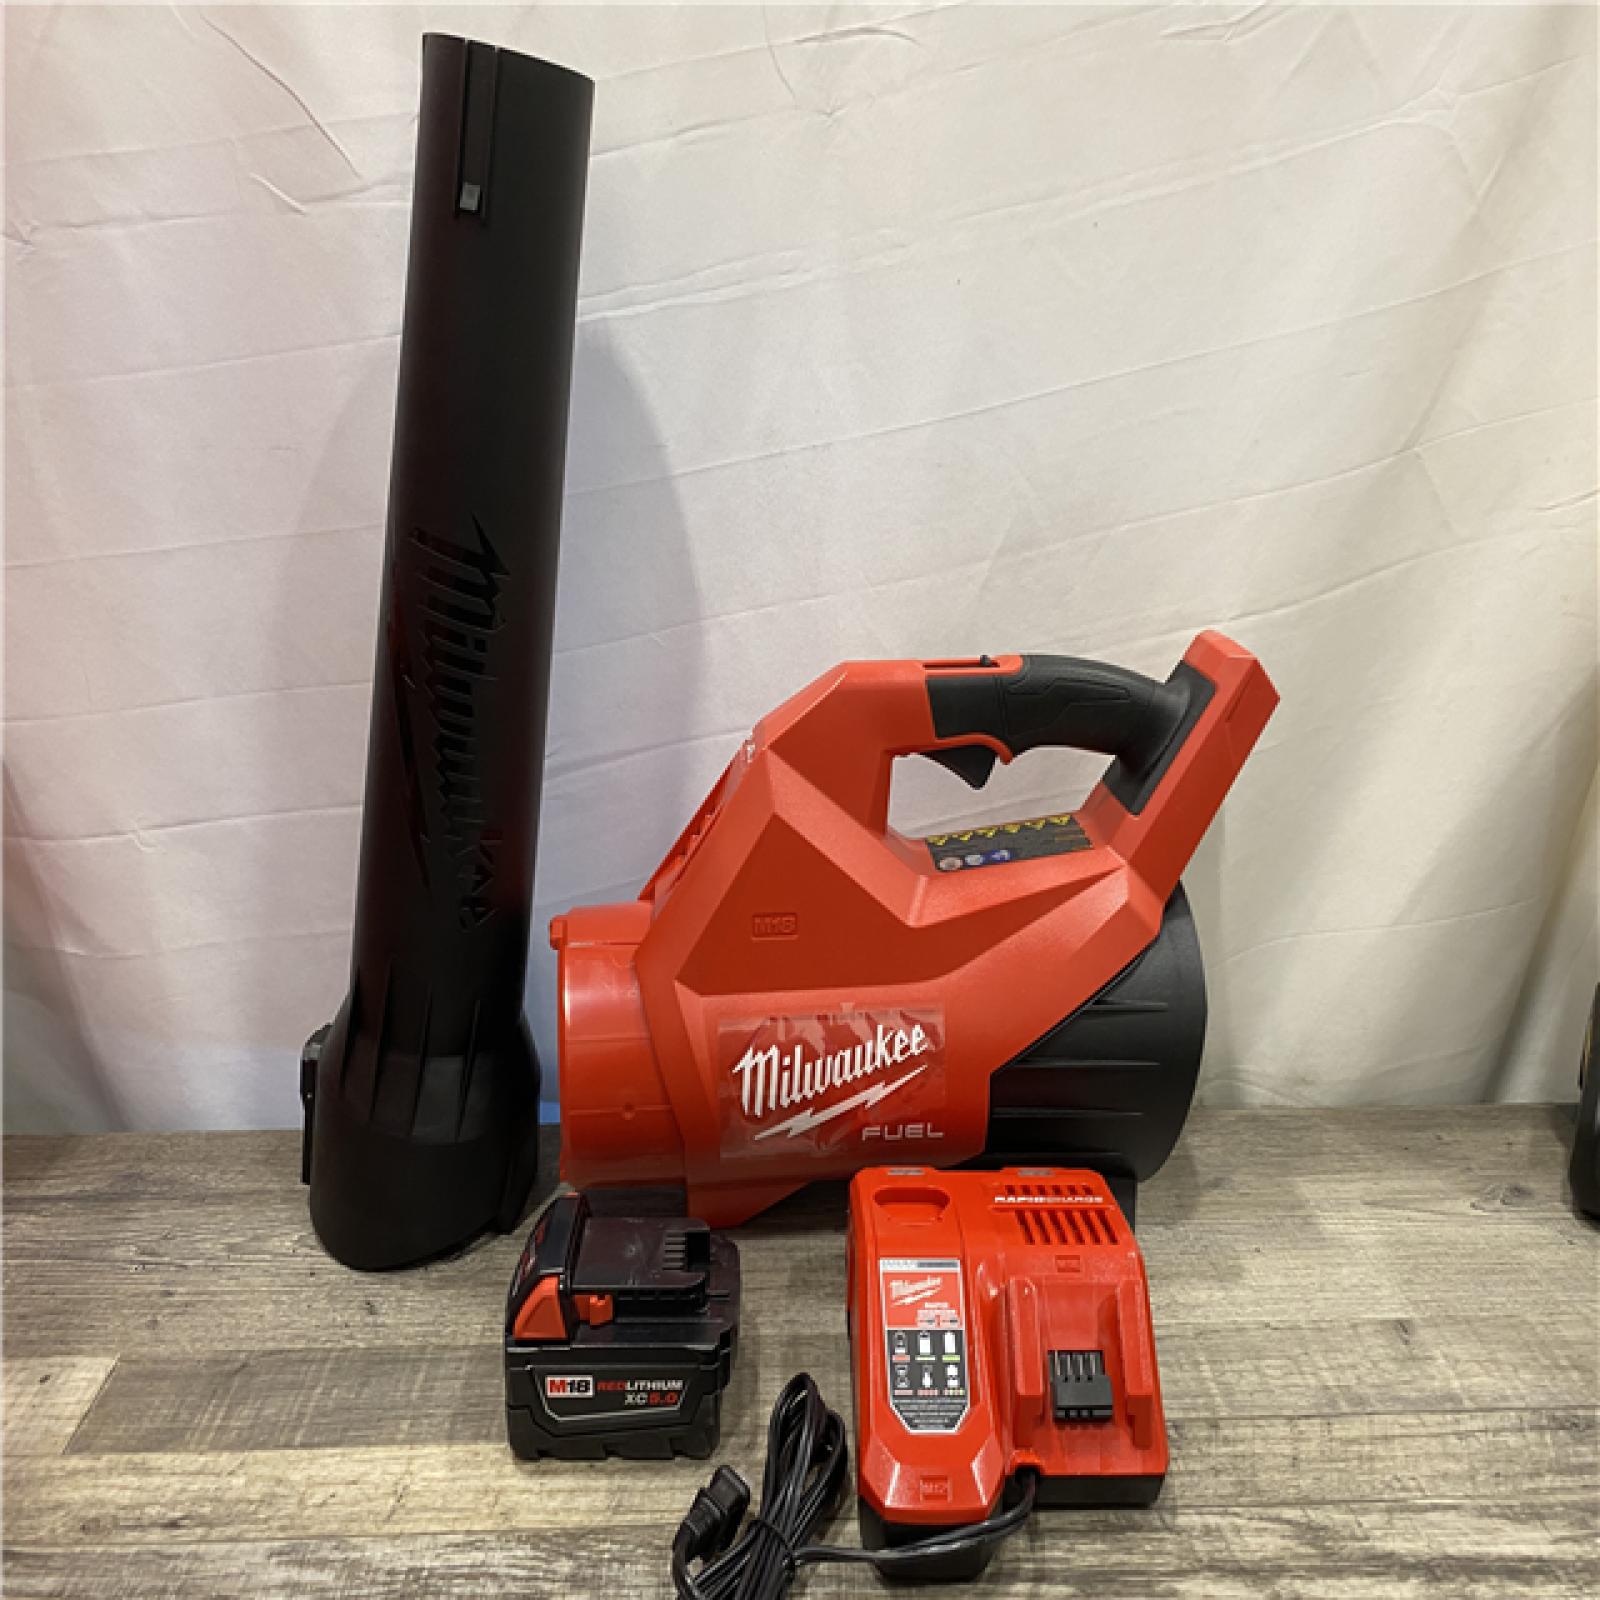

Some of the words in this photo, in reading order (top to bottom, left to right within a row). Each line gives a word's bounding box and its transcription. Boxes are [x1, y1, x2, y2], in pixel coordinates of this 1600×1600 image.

[732, 1023, 928, 1118] Milwaukee
[862, 1122, 944, 1141] FUEL
[549, 1379, 591, 1393] M18
